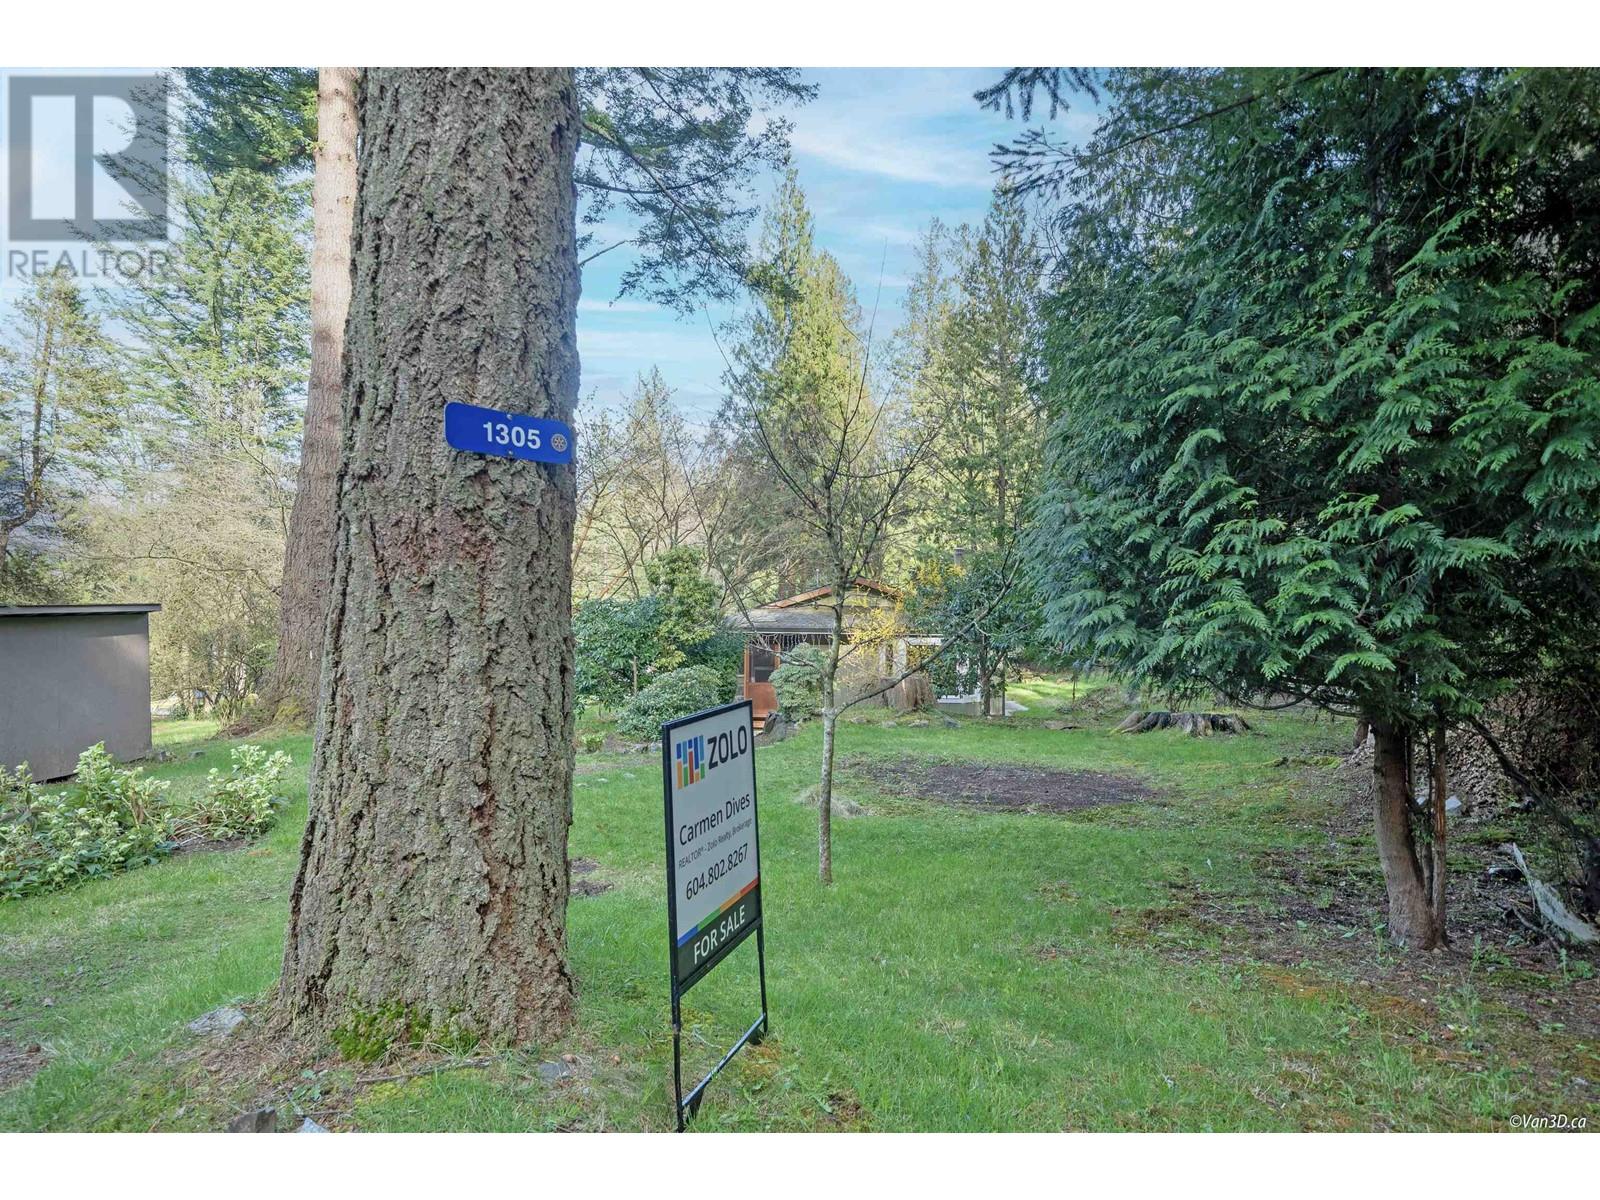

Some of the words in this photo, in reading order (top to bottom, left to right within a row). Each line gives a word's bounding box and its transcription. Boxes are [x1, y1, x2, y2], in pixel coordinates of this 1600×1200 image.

[483, 421, 541, 450] 1305
[707, 725, 748, 770] ZOLO
[679, 809, 723, 846] Carmen
[725, 794, 751, 820] Dives
[707, 838, 718, 852] Zolo
[686, 843, 748, 900] 604.802.8267
[694, 928, 718, 965] FOR
[720, 904, 745, 942] SALE
